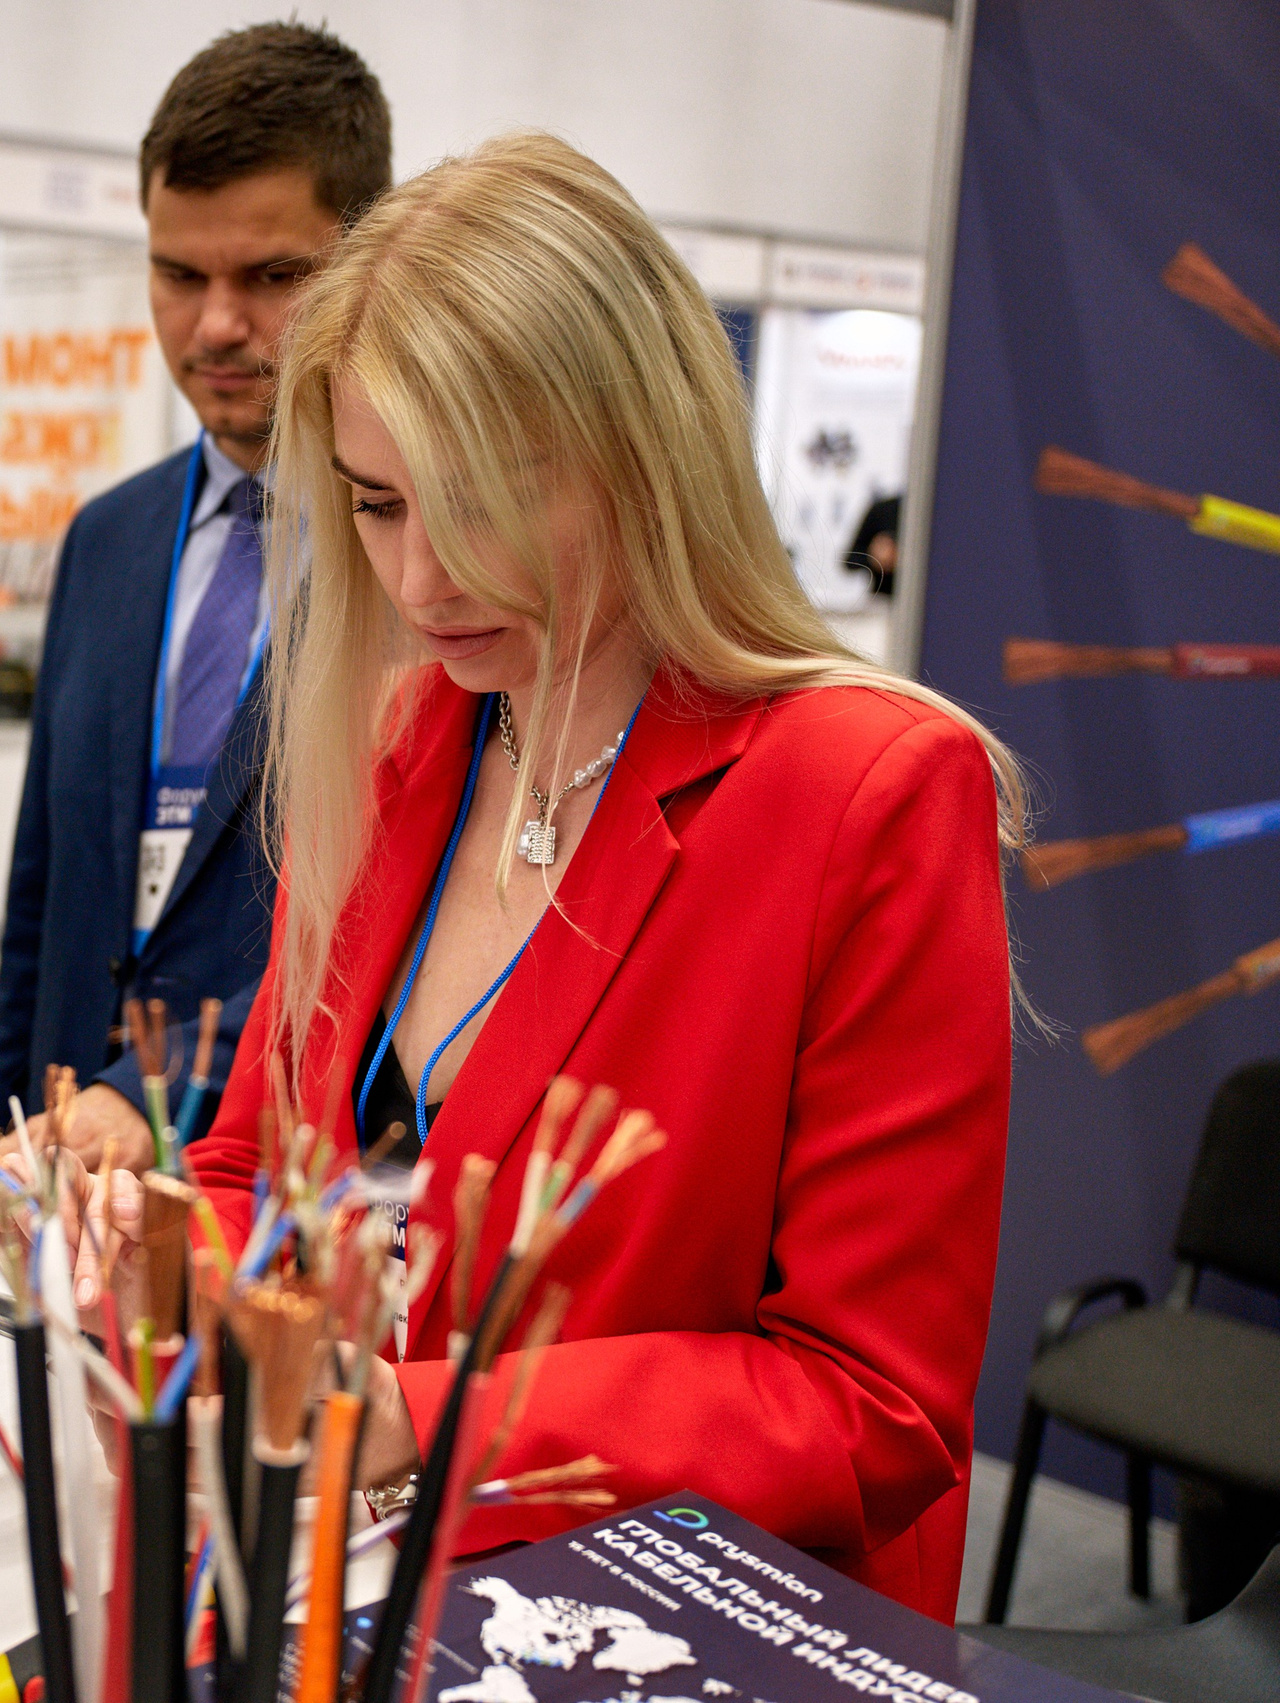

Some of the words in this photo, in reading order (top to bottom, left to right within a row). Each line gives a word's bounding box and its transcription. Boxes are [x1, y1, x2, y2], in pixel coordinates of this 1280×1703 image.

[581, 1549, 614, 1567] ЛЕТ
[608, 1565, 624, 1576] В
[620, 1572, 682, 1612] РОССИИ
[593, 1528, 795, 1646] КАБЕЛЬНОЙ
[618, 1519, 848, 1650] ГЛОБАЛЬНЫЙ
